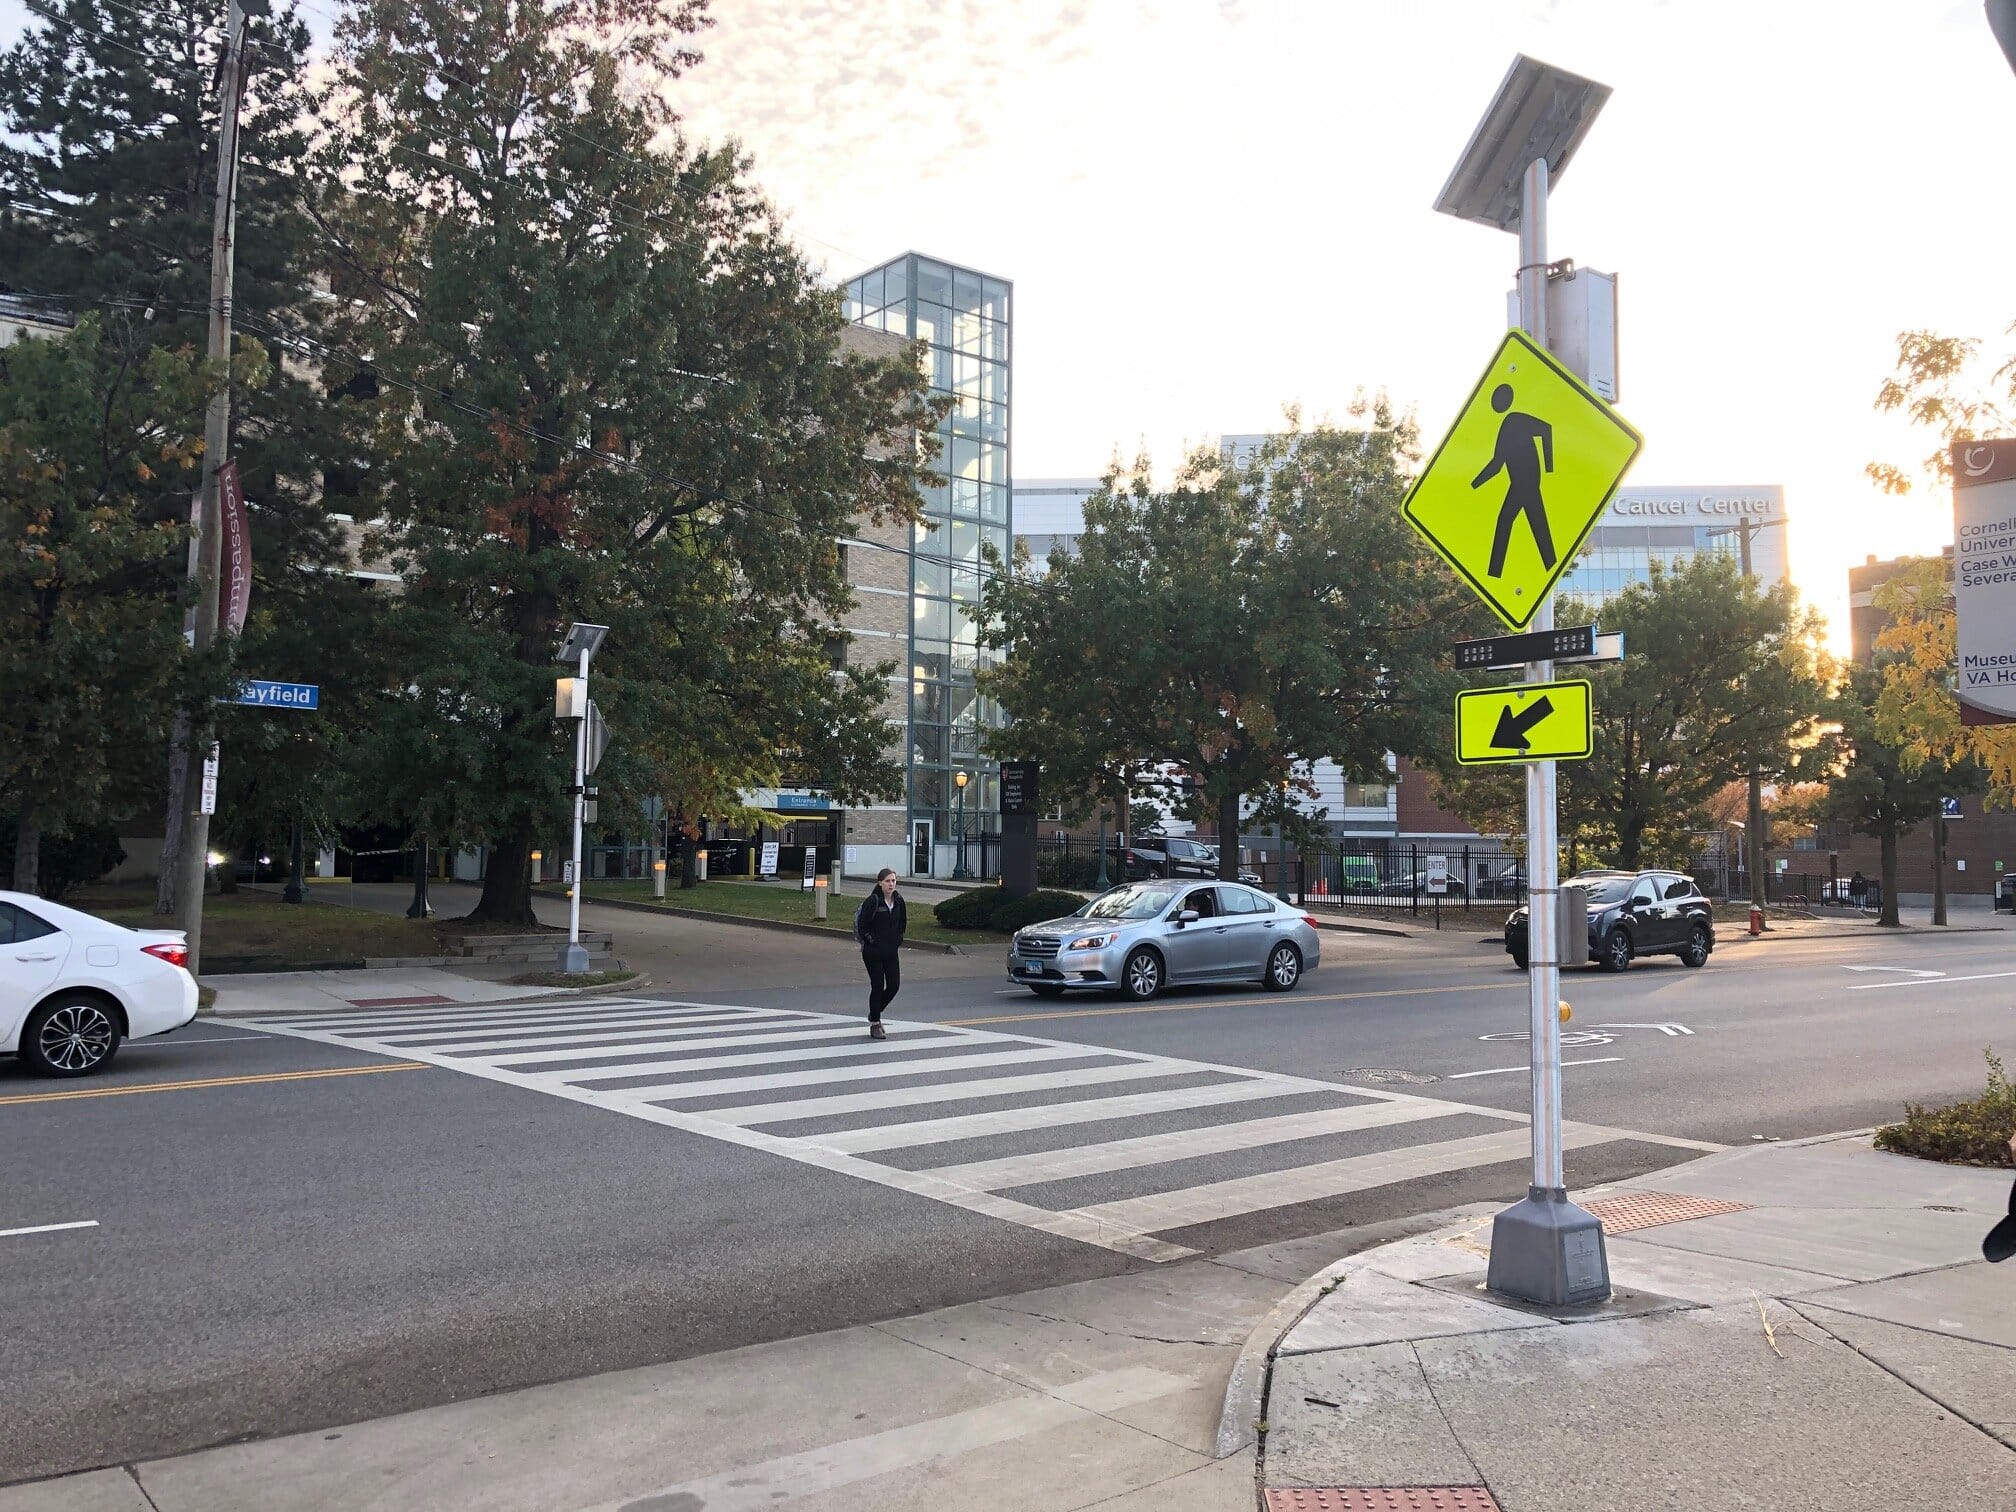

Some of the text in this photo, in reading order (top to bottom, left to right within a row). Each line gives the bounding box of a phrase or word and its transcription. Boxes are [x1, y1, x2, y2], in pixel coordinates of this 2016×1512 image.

[1613, 494, 1774, 515] Cancer Center
[224, 474, 245, 632] ompassion
[1961, 559, 1998, 572] Case
[1966, 671, 1991, 685] VA
[241, 685, 310, 704] ayfield
[1428, 860, 1446, 870] ENTER
